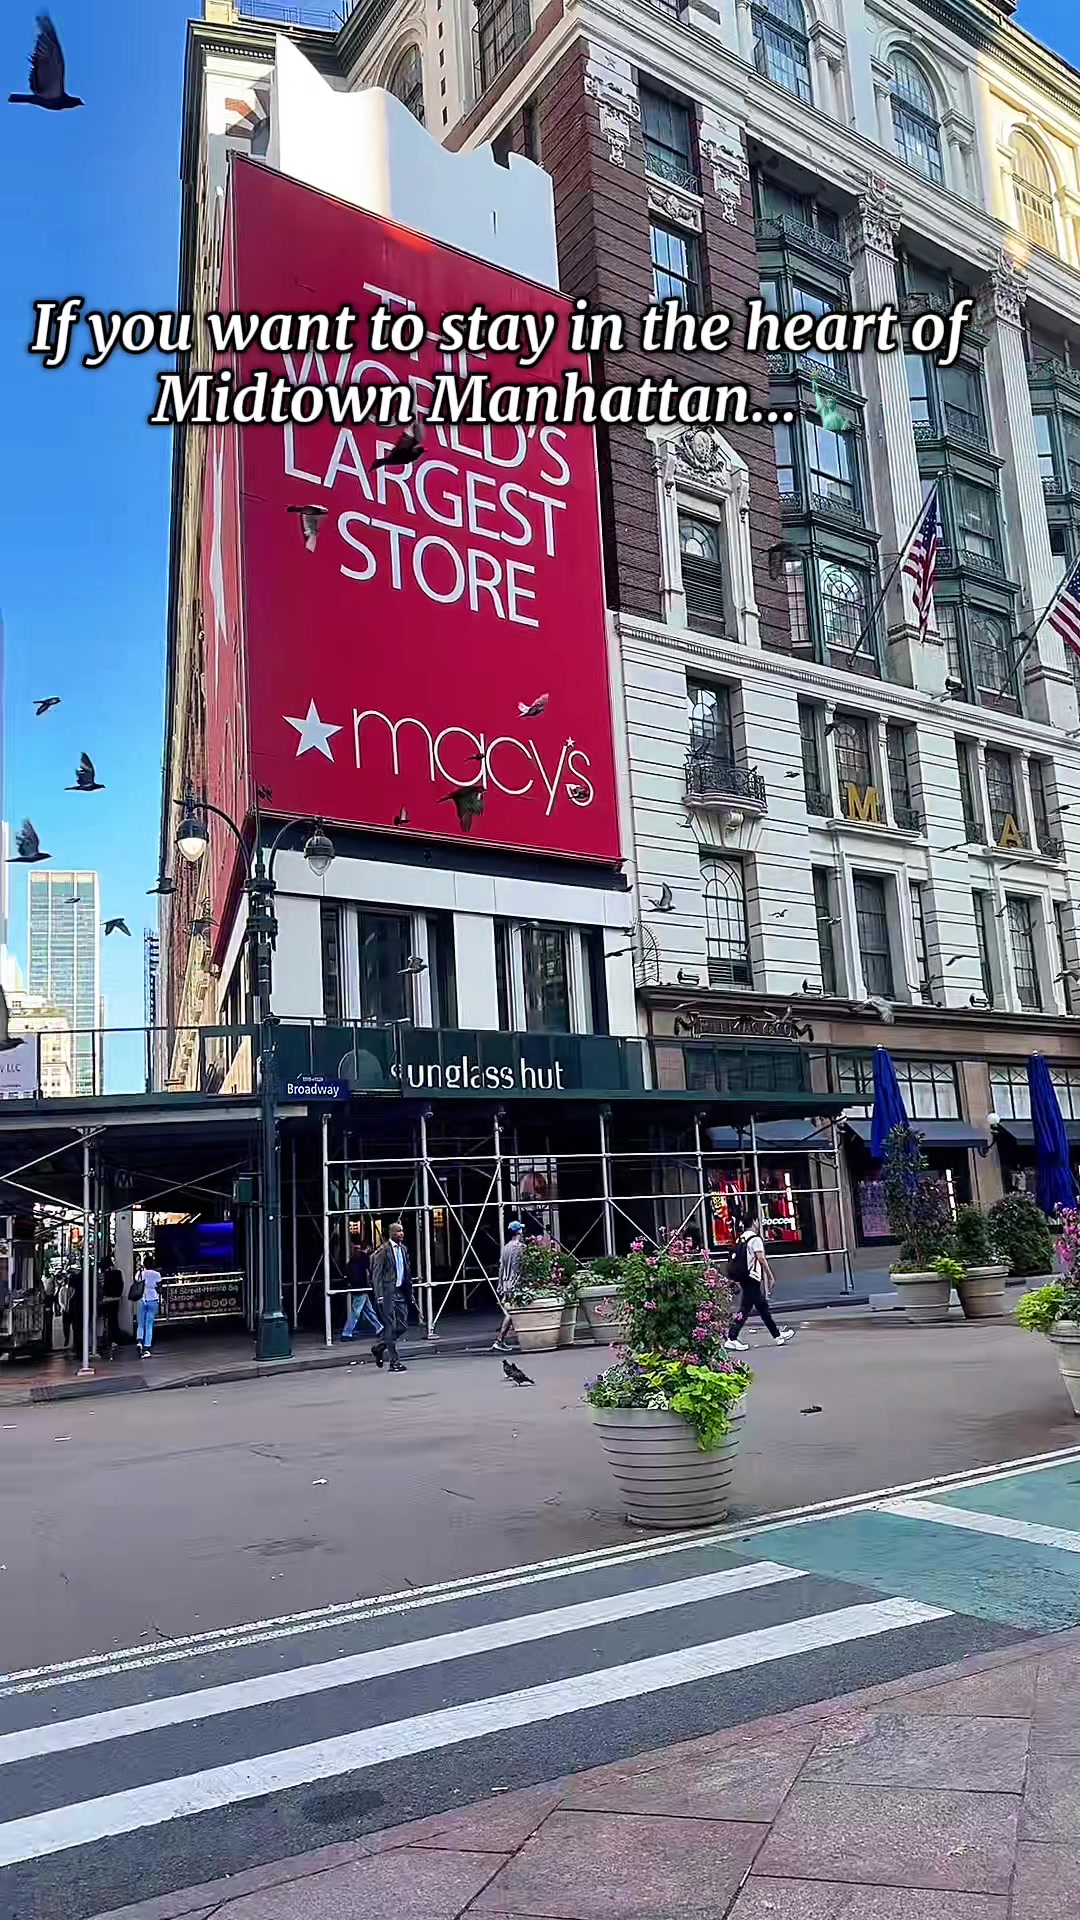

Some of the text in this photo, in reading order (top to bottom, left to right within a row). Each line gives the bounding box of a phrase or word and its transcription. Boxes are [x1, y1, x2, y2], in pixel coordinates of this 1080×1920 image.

[284, 421, 566, 557] LARGEST
[337, 511, 539, 628] STORE
[843, 782, 1024, 847] M A
[287, 1083, 340, 1098] Broadway
[520, 1057, 565, 1090] hut
